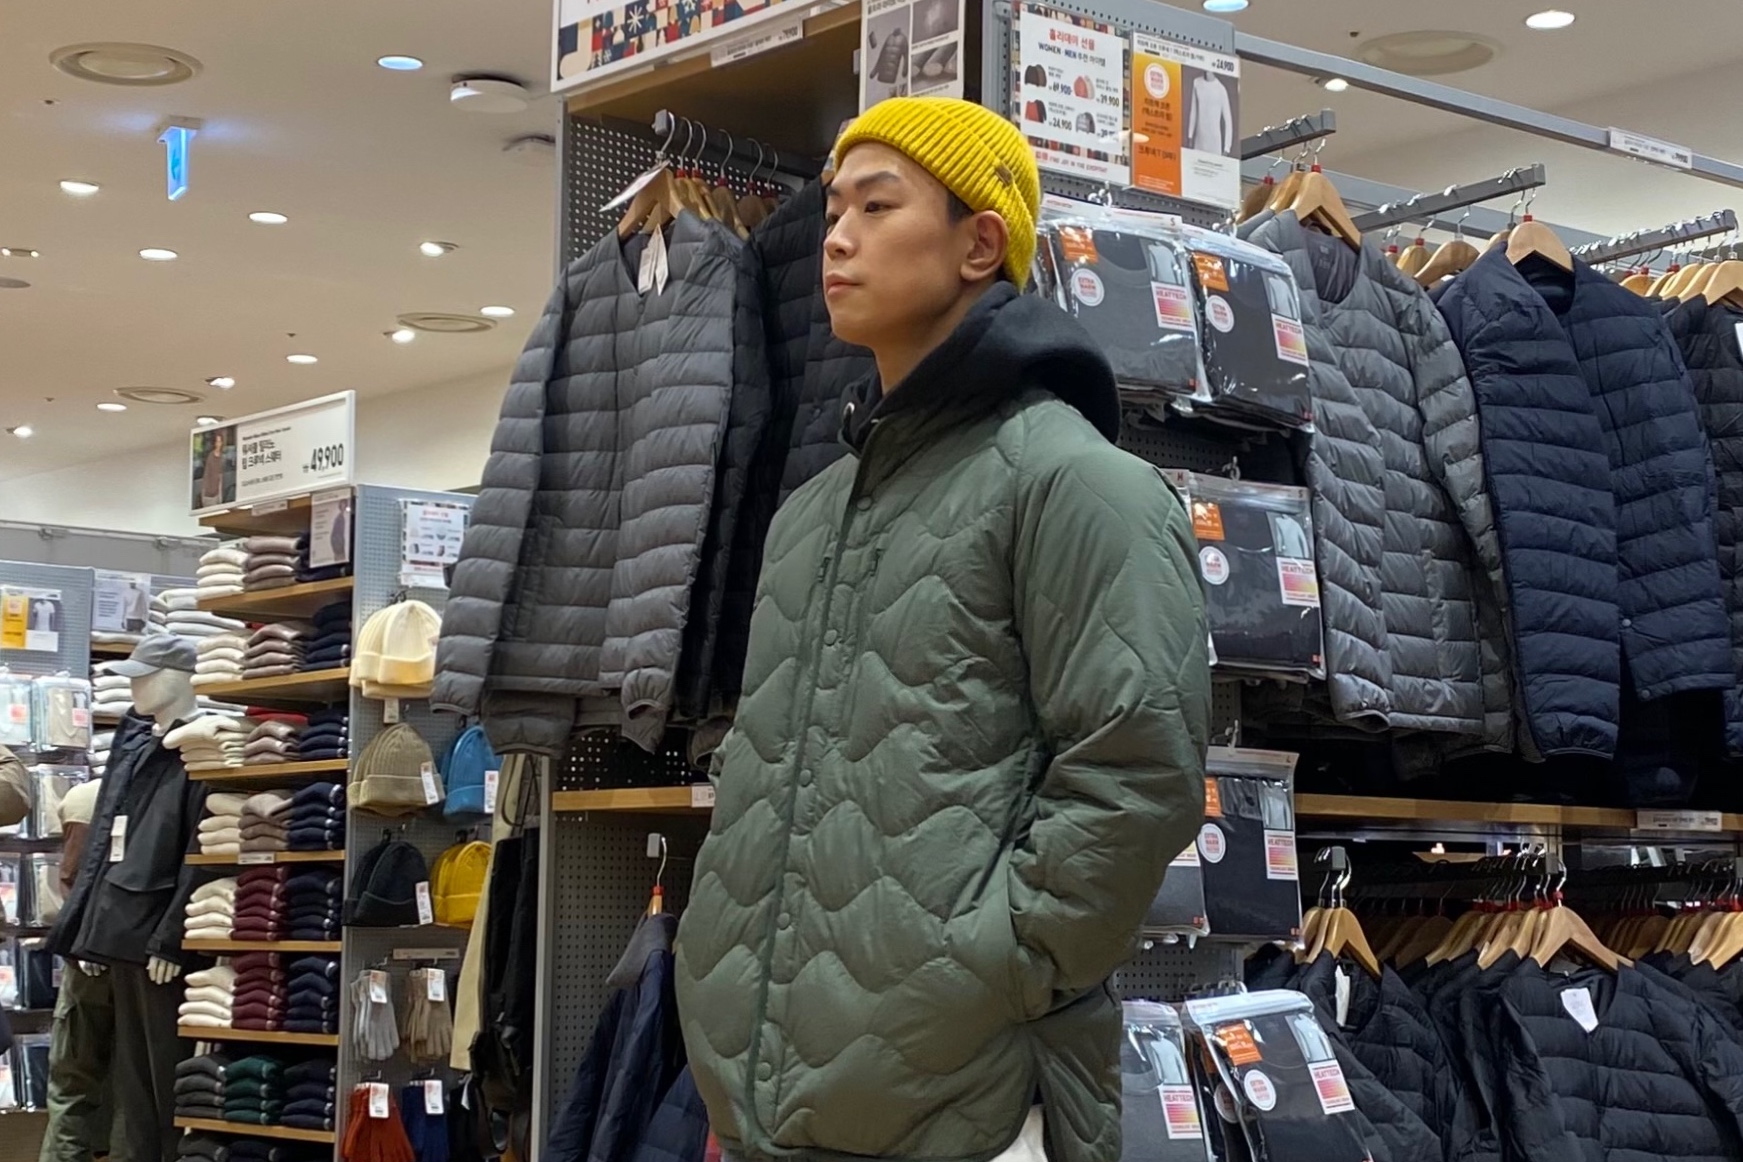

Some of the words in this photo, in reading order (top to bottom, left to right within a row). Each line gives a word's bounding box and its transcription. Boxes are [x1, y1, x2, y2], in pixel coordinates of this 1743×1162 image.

[1049, 28, 1079, 46] 홀리데이
[1081, 37, 1095, 51] 선물
[1038, 41, 1061, 55] WOMEN
[1169, 217, 1177, 227] S
[1156, 290, 1187, 300] HEATTECH
[310, 443, 344, 472] 49,900
